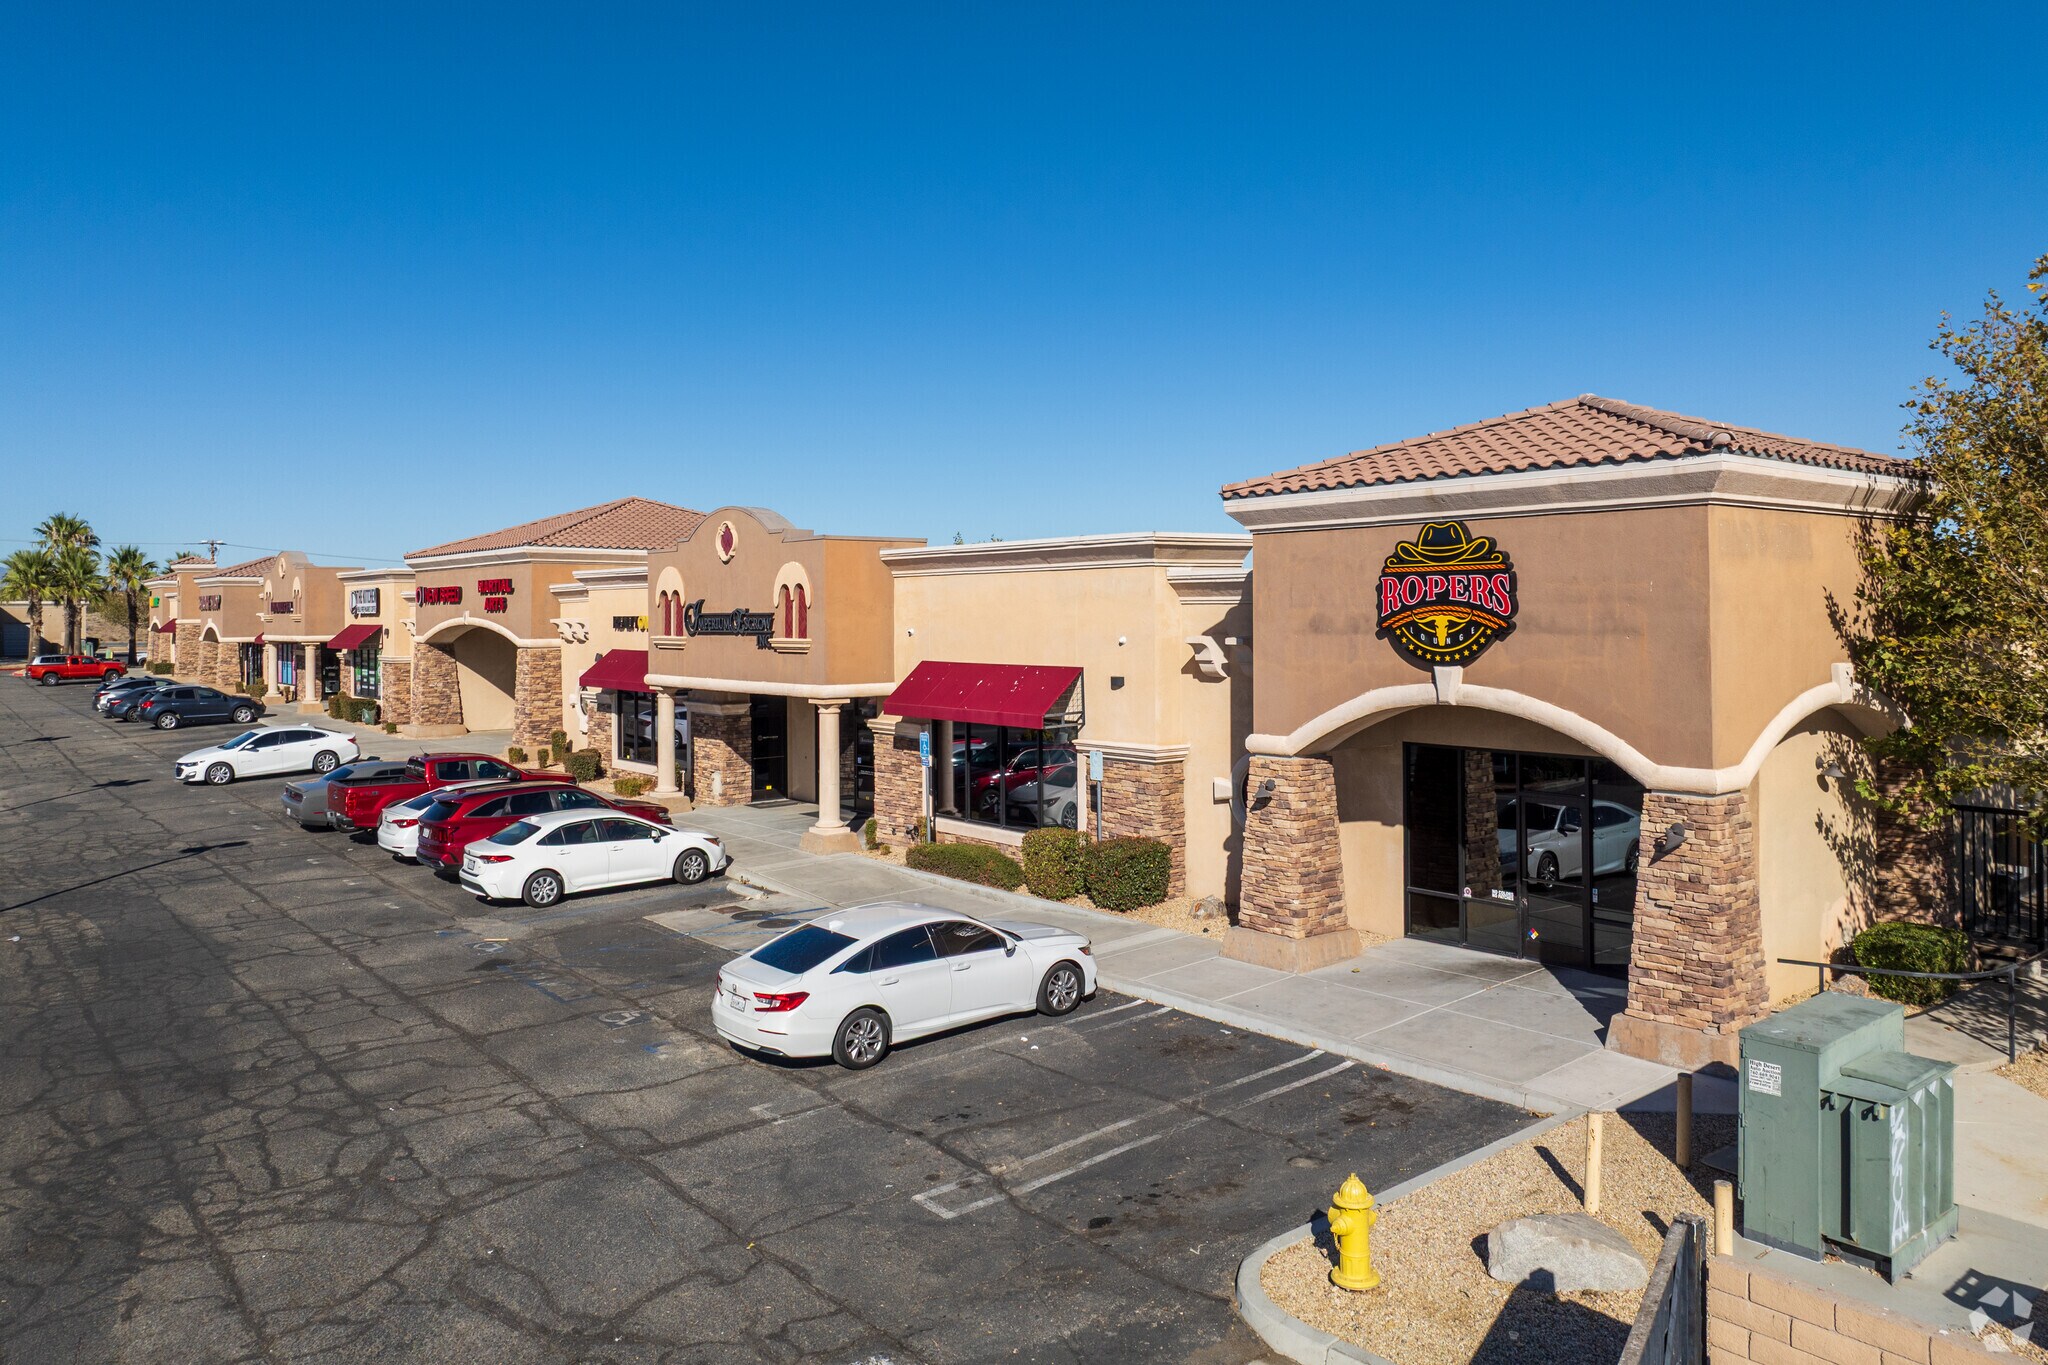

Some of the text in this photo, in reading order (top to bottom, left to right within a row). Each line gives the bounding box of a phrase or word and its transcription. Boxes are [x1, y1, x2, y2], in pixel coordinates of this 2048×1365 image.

[477, 579, 511, 594] MARTIAL
[1381, 574, 1511, 616] ROPERS
[484, 597, 505, 611] ARTS
[1410, 627, 1475, 645] LOUNGE
[1763, 1062, 1780, 1070] Desert
